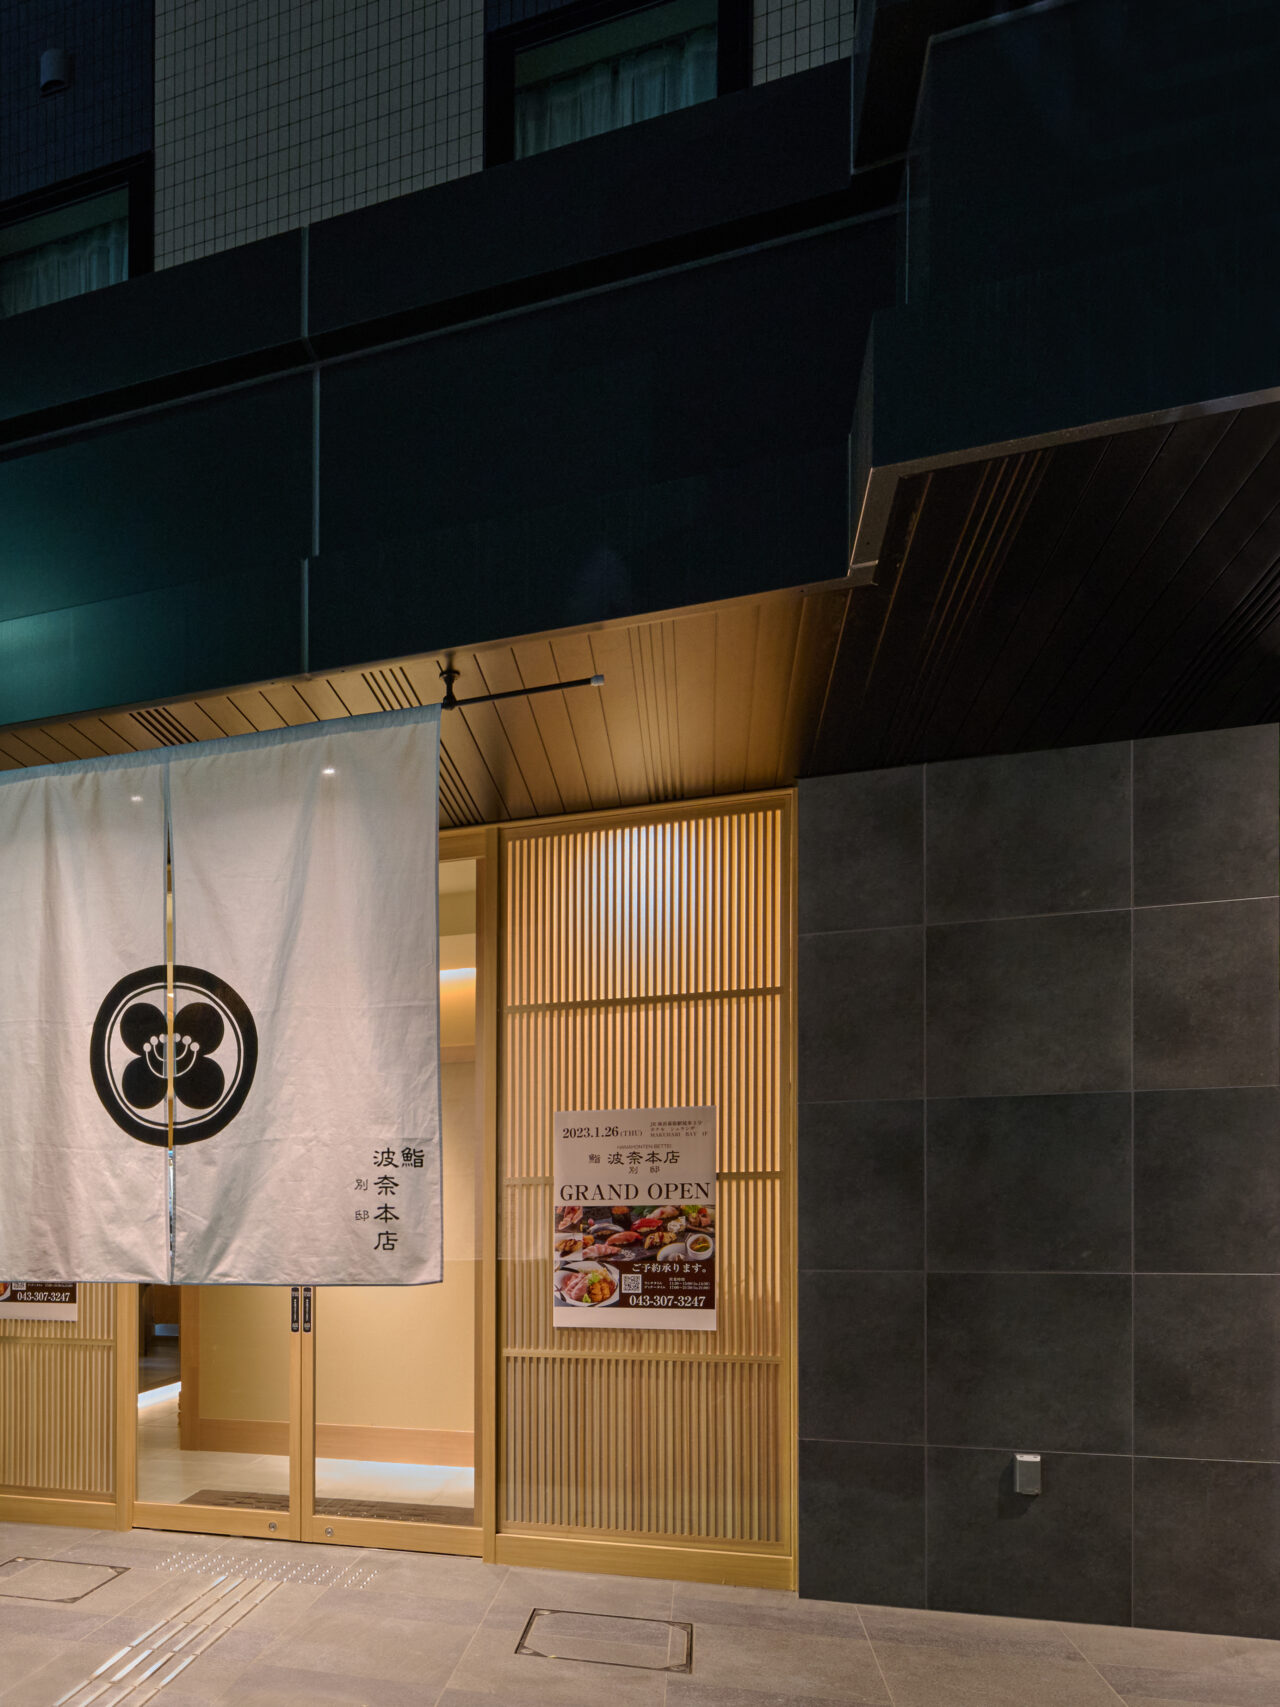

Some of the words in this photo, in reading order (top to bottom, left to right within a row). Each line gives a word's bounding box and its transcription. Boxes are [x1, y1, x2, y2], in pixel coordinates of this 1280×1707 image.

[401, 1147, 425, 1168] 鮨
[608, 1150, 680, 1165] 波奈本店
[373, 1147, 400, 1250] 波奈本店
[560, 1183, 639, 1201] GRAND
[648, 1182, 711, 1200] OPEN
[632, 1263, 707, 1273] ご予約承ります。
[17, 1291, 71, 1302] 043-307-3247
[629, 1295, 706, 1307] 043-307-3247
